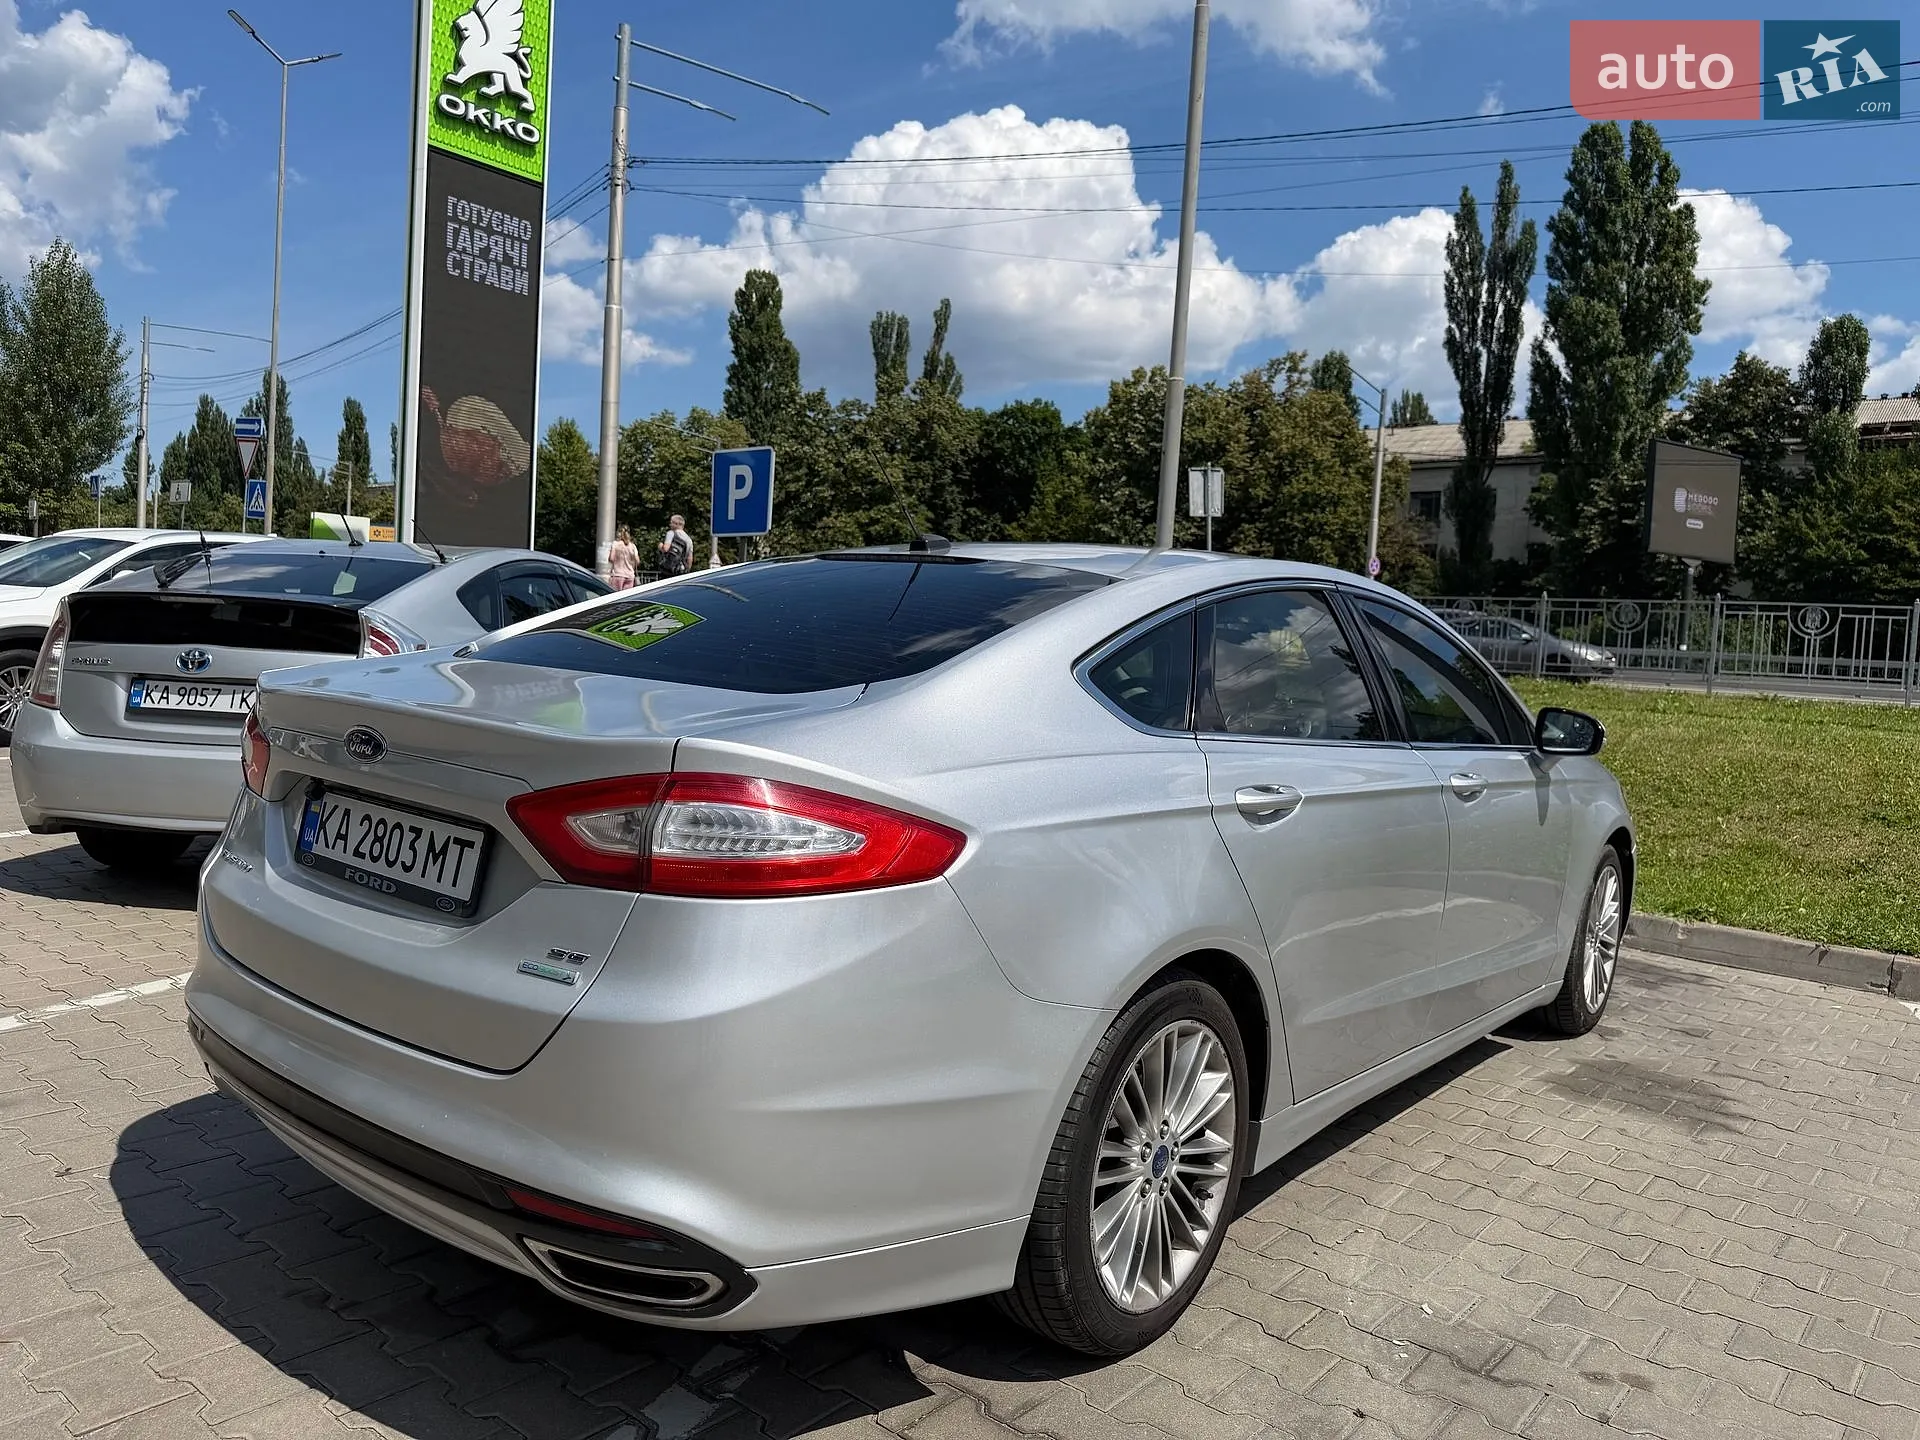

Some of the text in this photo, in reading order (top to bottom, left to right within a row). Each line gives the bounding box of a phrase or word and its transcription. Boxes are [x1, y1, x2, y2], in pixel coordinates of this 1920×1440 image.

[437, 93, 542, 145] OKKO
[446, 195, 533, 241] ГОТУЄМО
[445, 221, 529, 268] ГАРЯЧІ
[445, 250, 529, 296] СТРАВИ
[727, 464, 753, 521] P
[143, 684, 256, 710] KA 9057 IK
[303, 826, 314, 844] UA
[315, 801, 476, 888] KA 2803 MT
[344, 867, 398, 894] FORD
